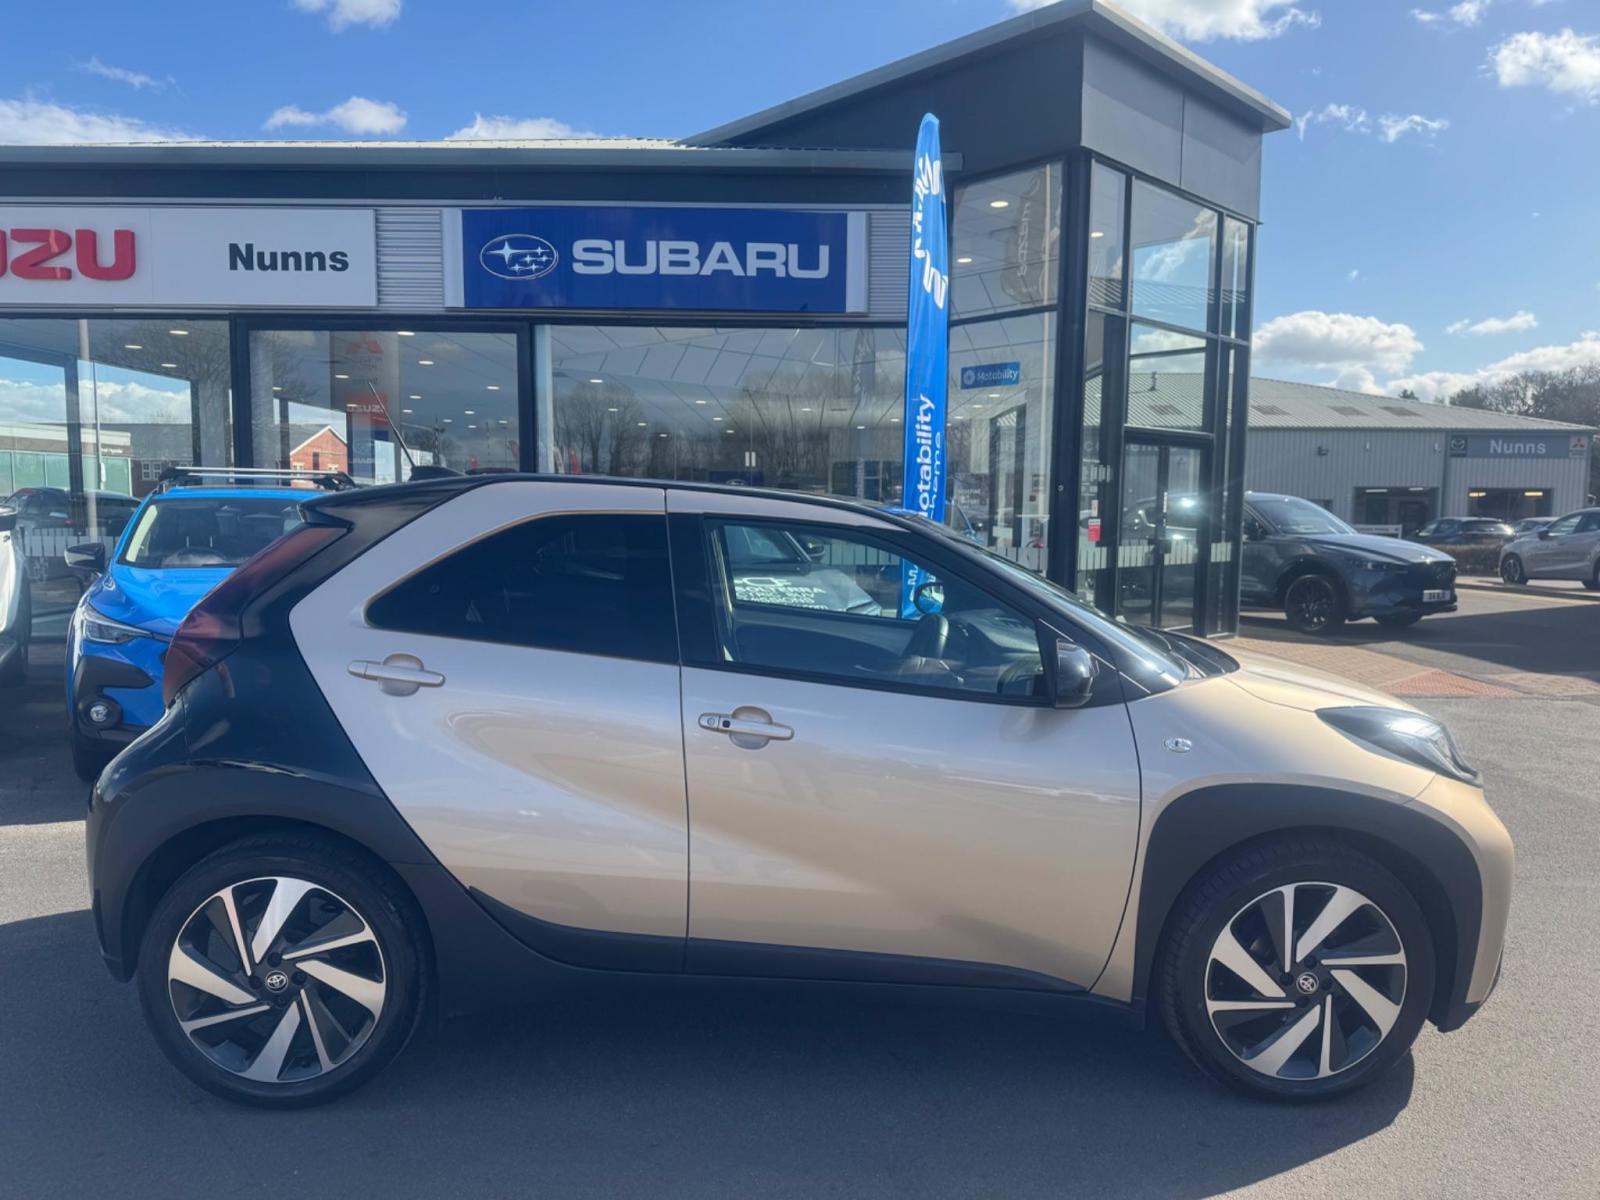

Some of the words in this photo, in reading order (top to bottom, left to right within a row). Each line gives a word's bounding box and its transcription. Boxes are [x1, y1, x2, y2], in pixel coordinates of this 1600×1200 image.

[0, 227, 136, 281] ZU
[228, 243, 349, 272] Nunns
[572, 239, 830, 279] SUBARU
[976, 366, 1019, 382] Motability
[915, 393, 936, 518] otability
[1489, 439, 1547, 455] Nunns
[930, 431, 941, 519] heme
